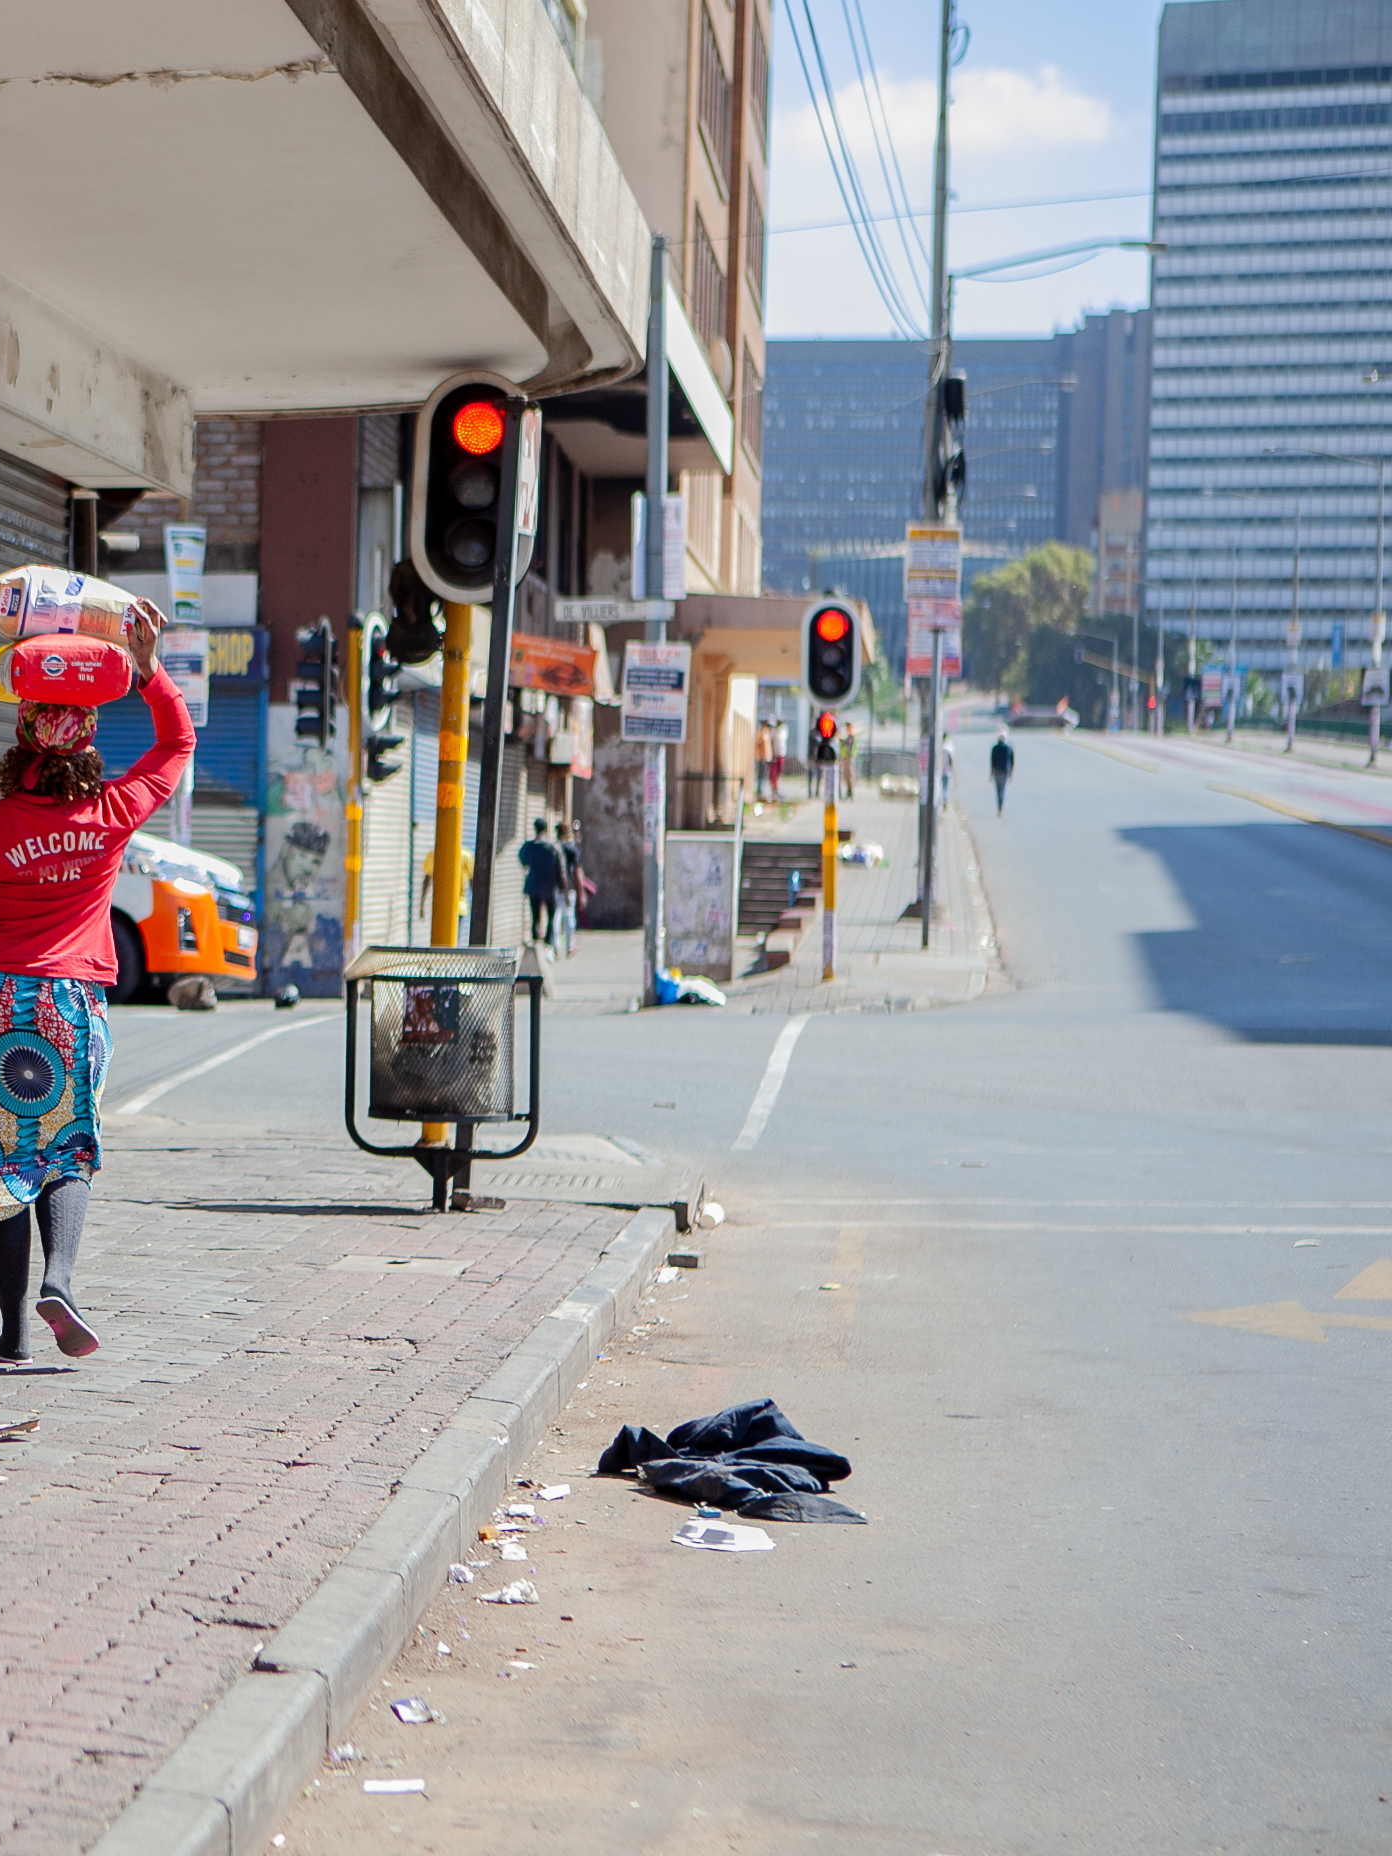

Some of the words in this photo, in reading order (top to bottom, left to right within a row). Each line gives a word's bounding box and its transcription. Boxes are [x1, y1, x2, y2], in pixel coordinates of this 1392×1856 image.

[563, 605, 574, 620] DE
[581, 605, 620, 619] VILLIERS
[78, 673, 85, 681] 10
[86, 673, 95, 683] kg
[5, 831, 110, 868] WELCOME
[38, 864, 58, 878] MY
